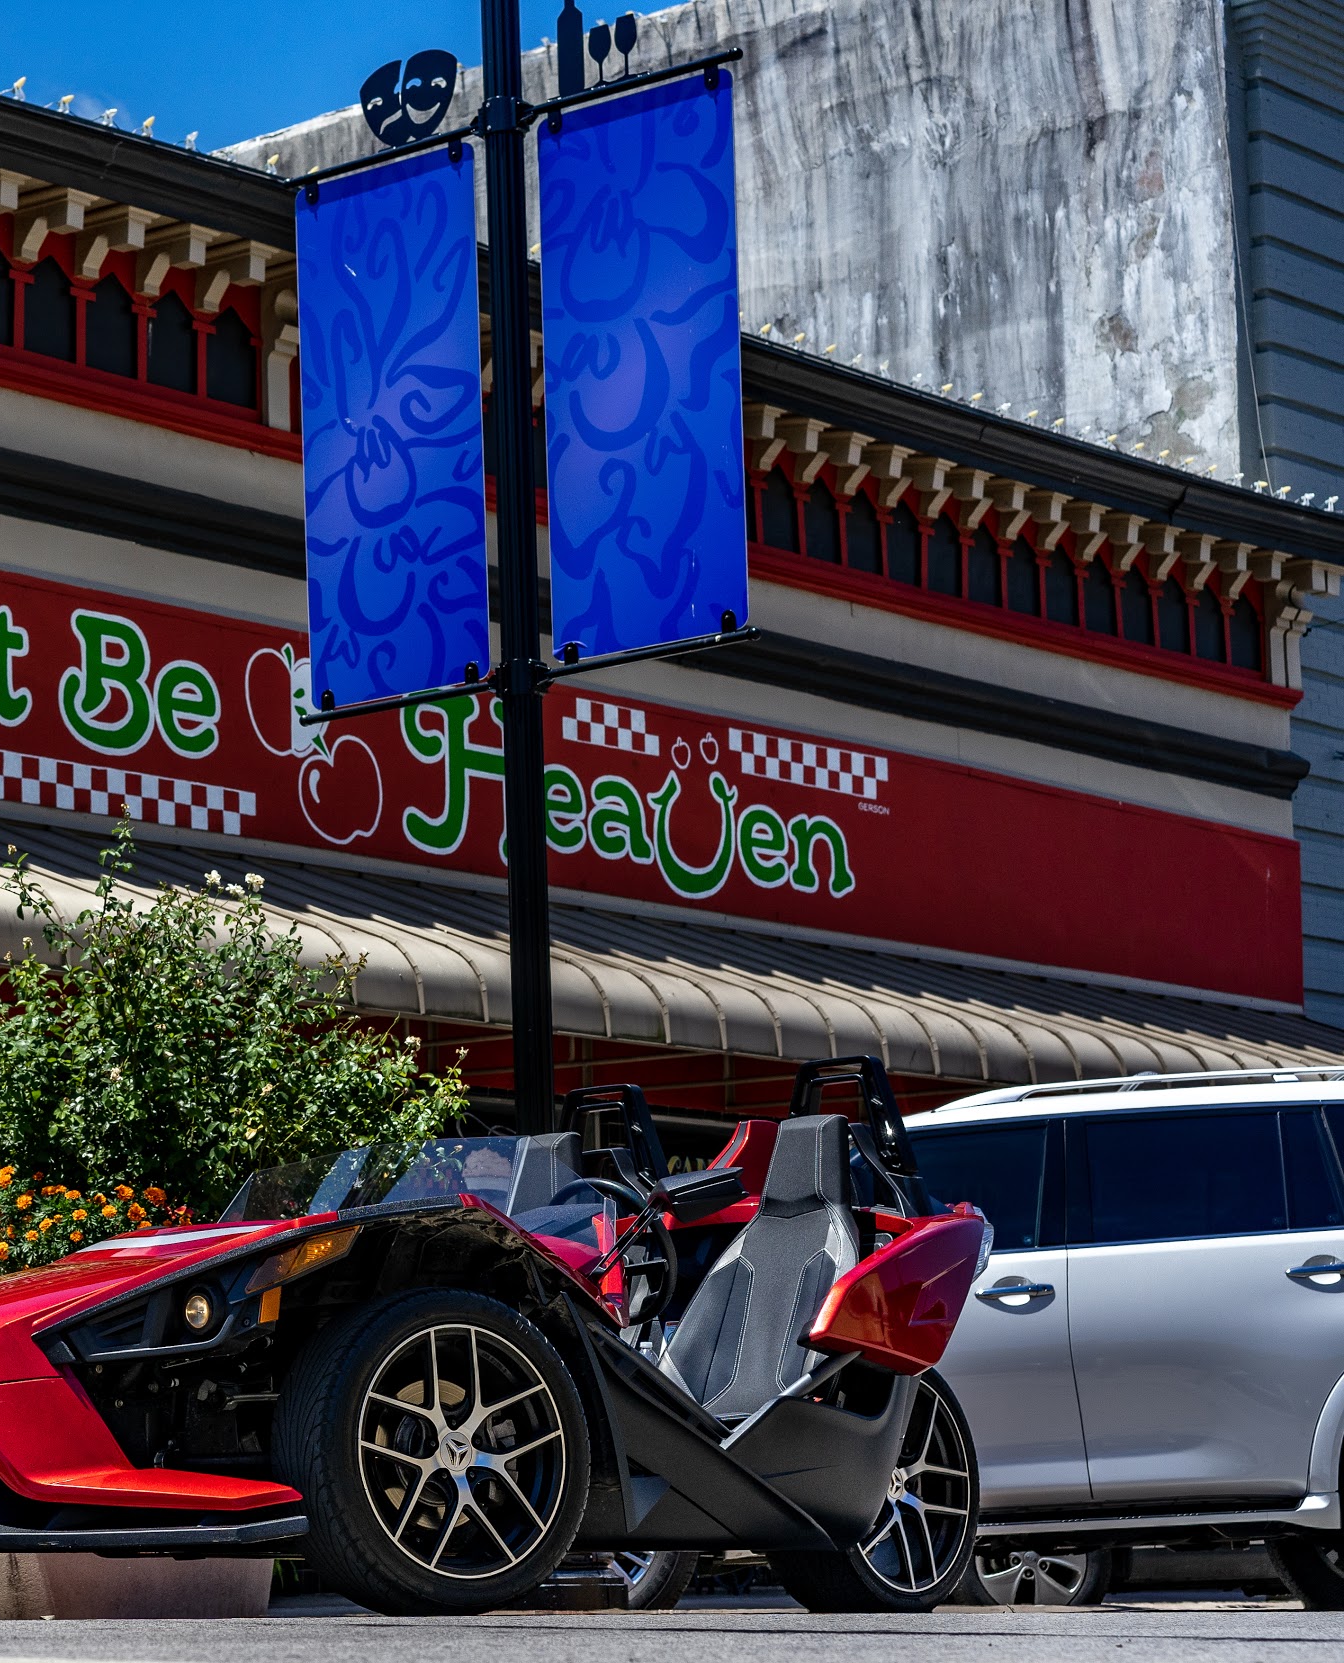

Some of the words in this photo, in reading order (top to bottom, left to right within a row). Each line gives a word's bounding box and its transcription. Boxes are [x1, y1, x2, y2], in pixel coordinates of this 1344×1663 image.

[58, 608, 221, 759] Be
[400, 690, 855, 898] Heaven
[857, 801, 890, 815] GERSON
